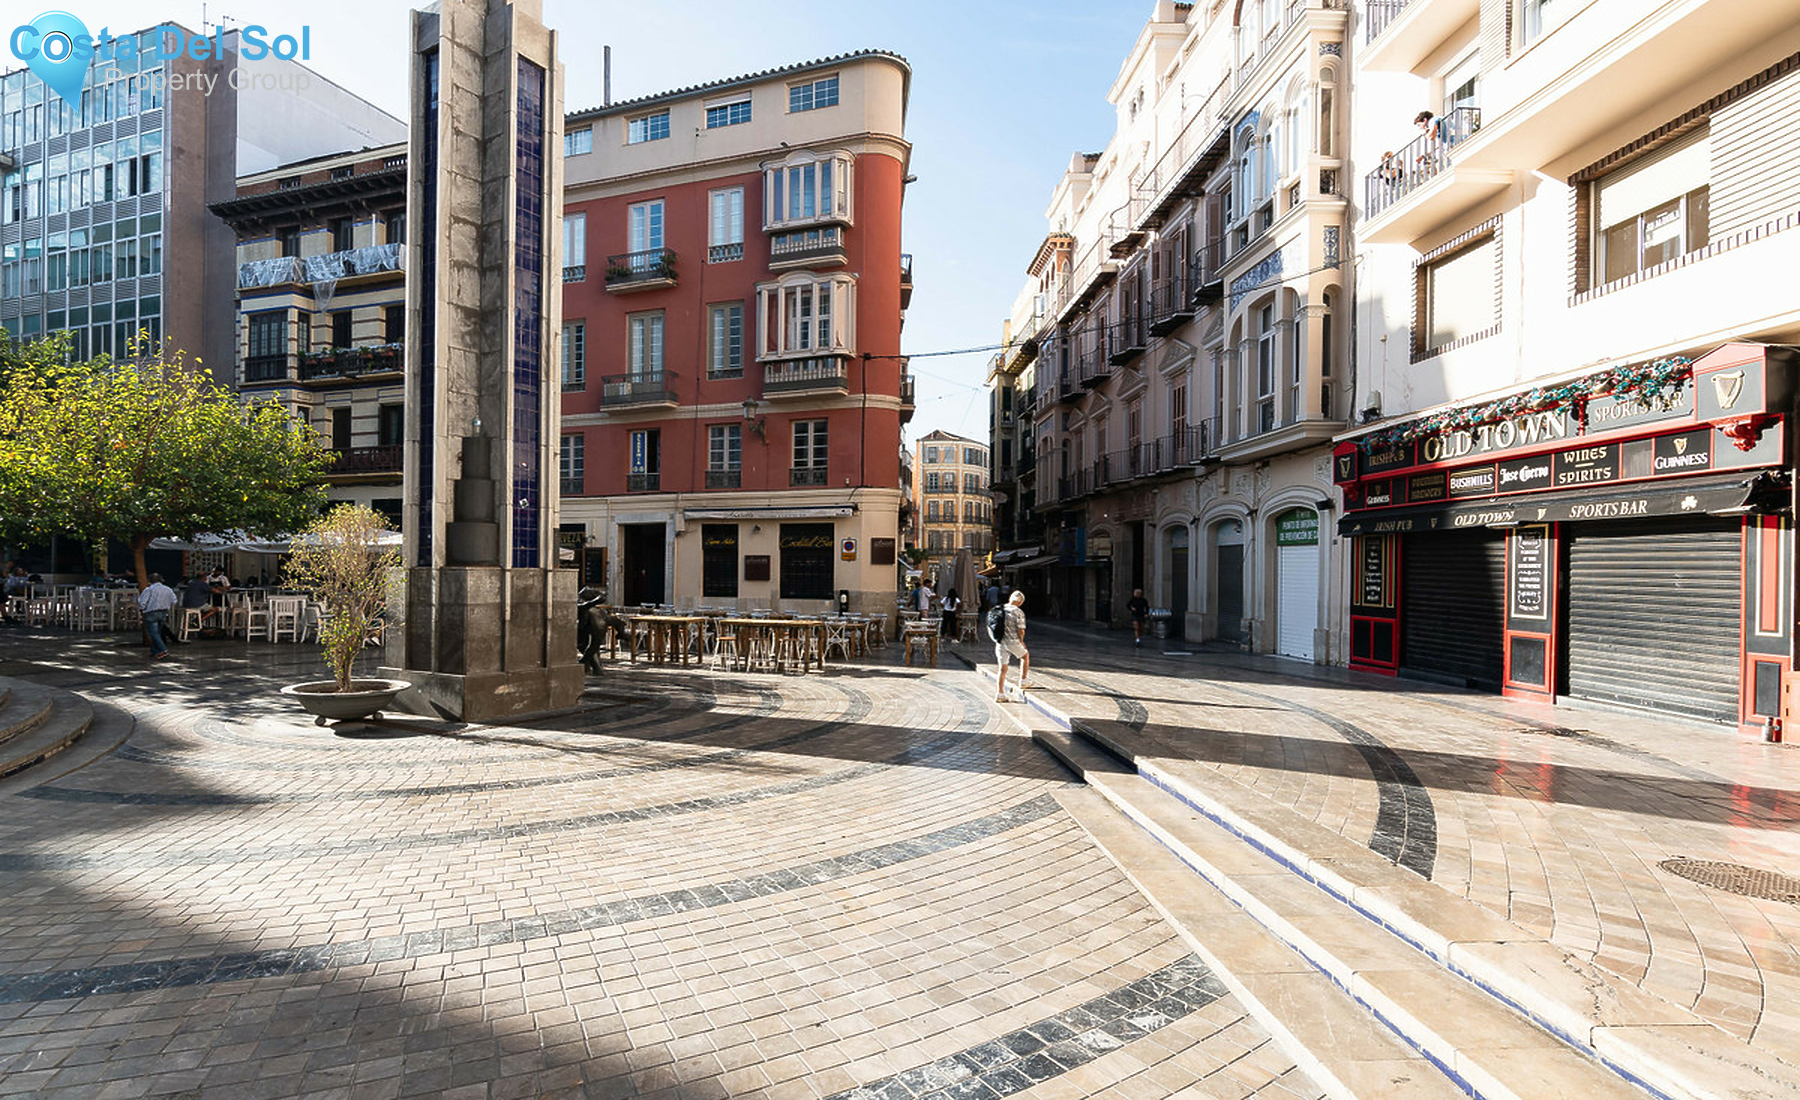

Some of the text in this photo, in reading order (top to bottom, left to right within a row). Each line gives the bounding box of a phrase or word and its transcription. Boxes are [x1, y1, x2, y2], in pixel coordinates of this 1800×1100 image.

[1594, 400, 1650, 422] SPORTS
[1424, 411, 1567, 461] OLD TOWN
[1564, 446, 1607, 463] WINES
[1654, 452, 1708, 470] GUINNESS
[1450, 474, 1493, 489] BUSHMILLS
[1559, 467, 1612, 484] SPIRITS
[1569, 500, 1648, 518] SPORTS BAR
[1454, 511, 1515, 526] OLD TOWN
